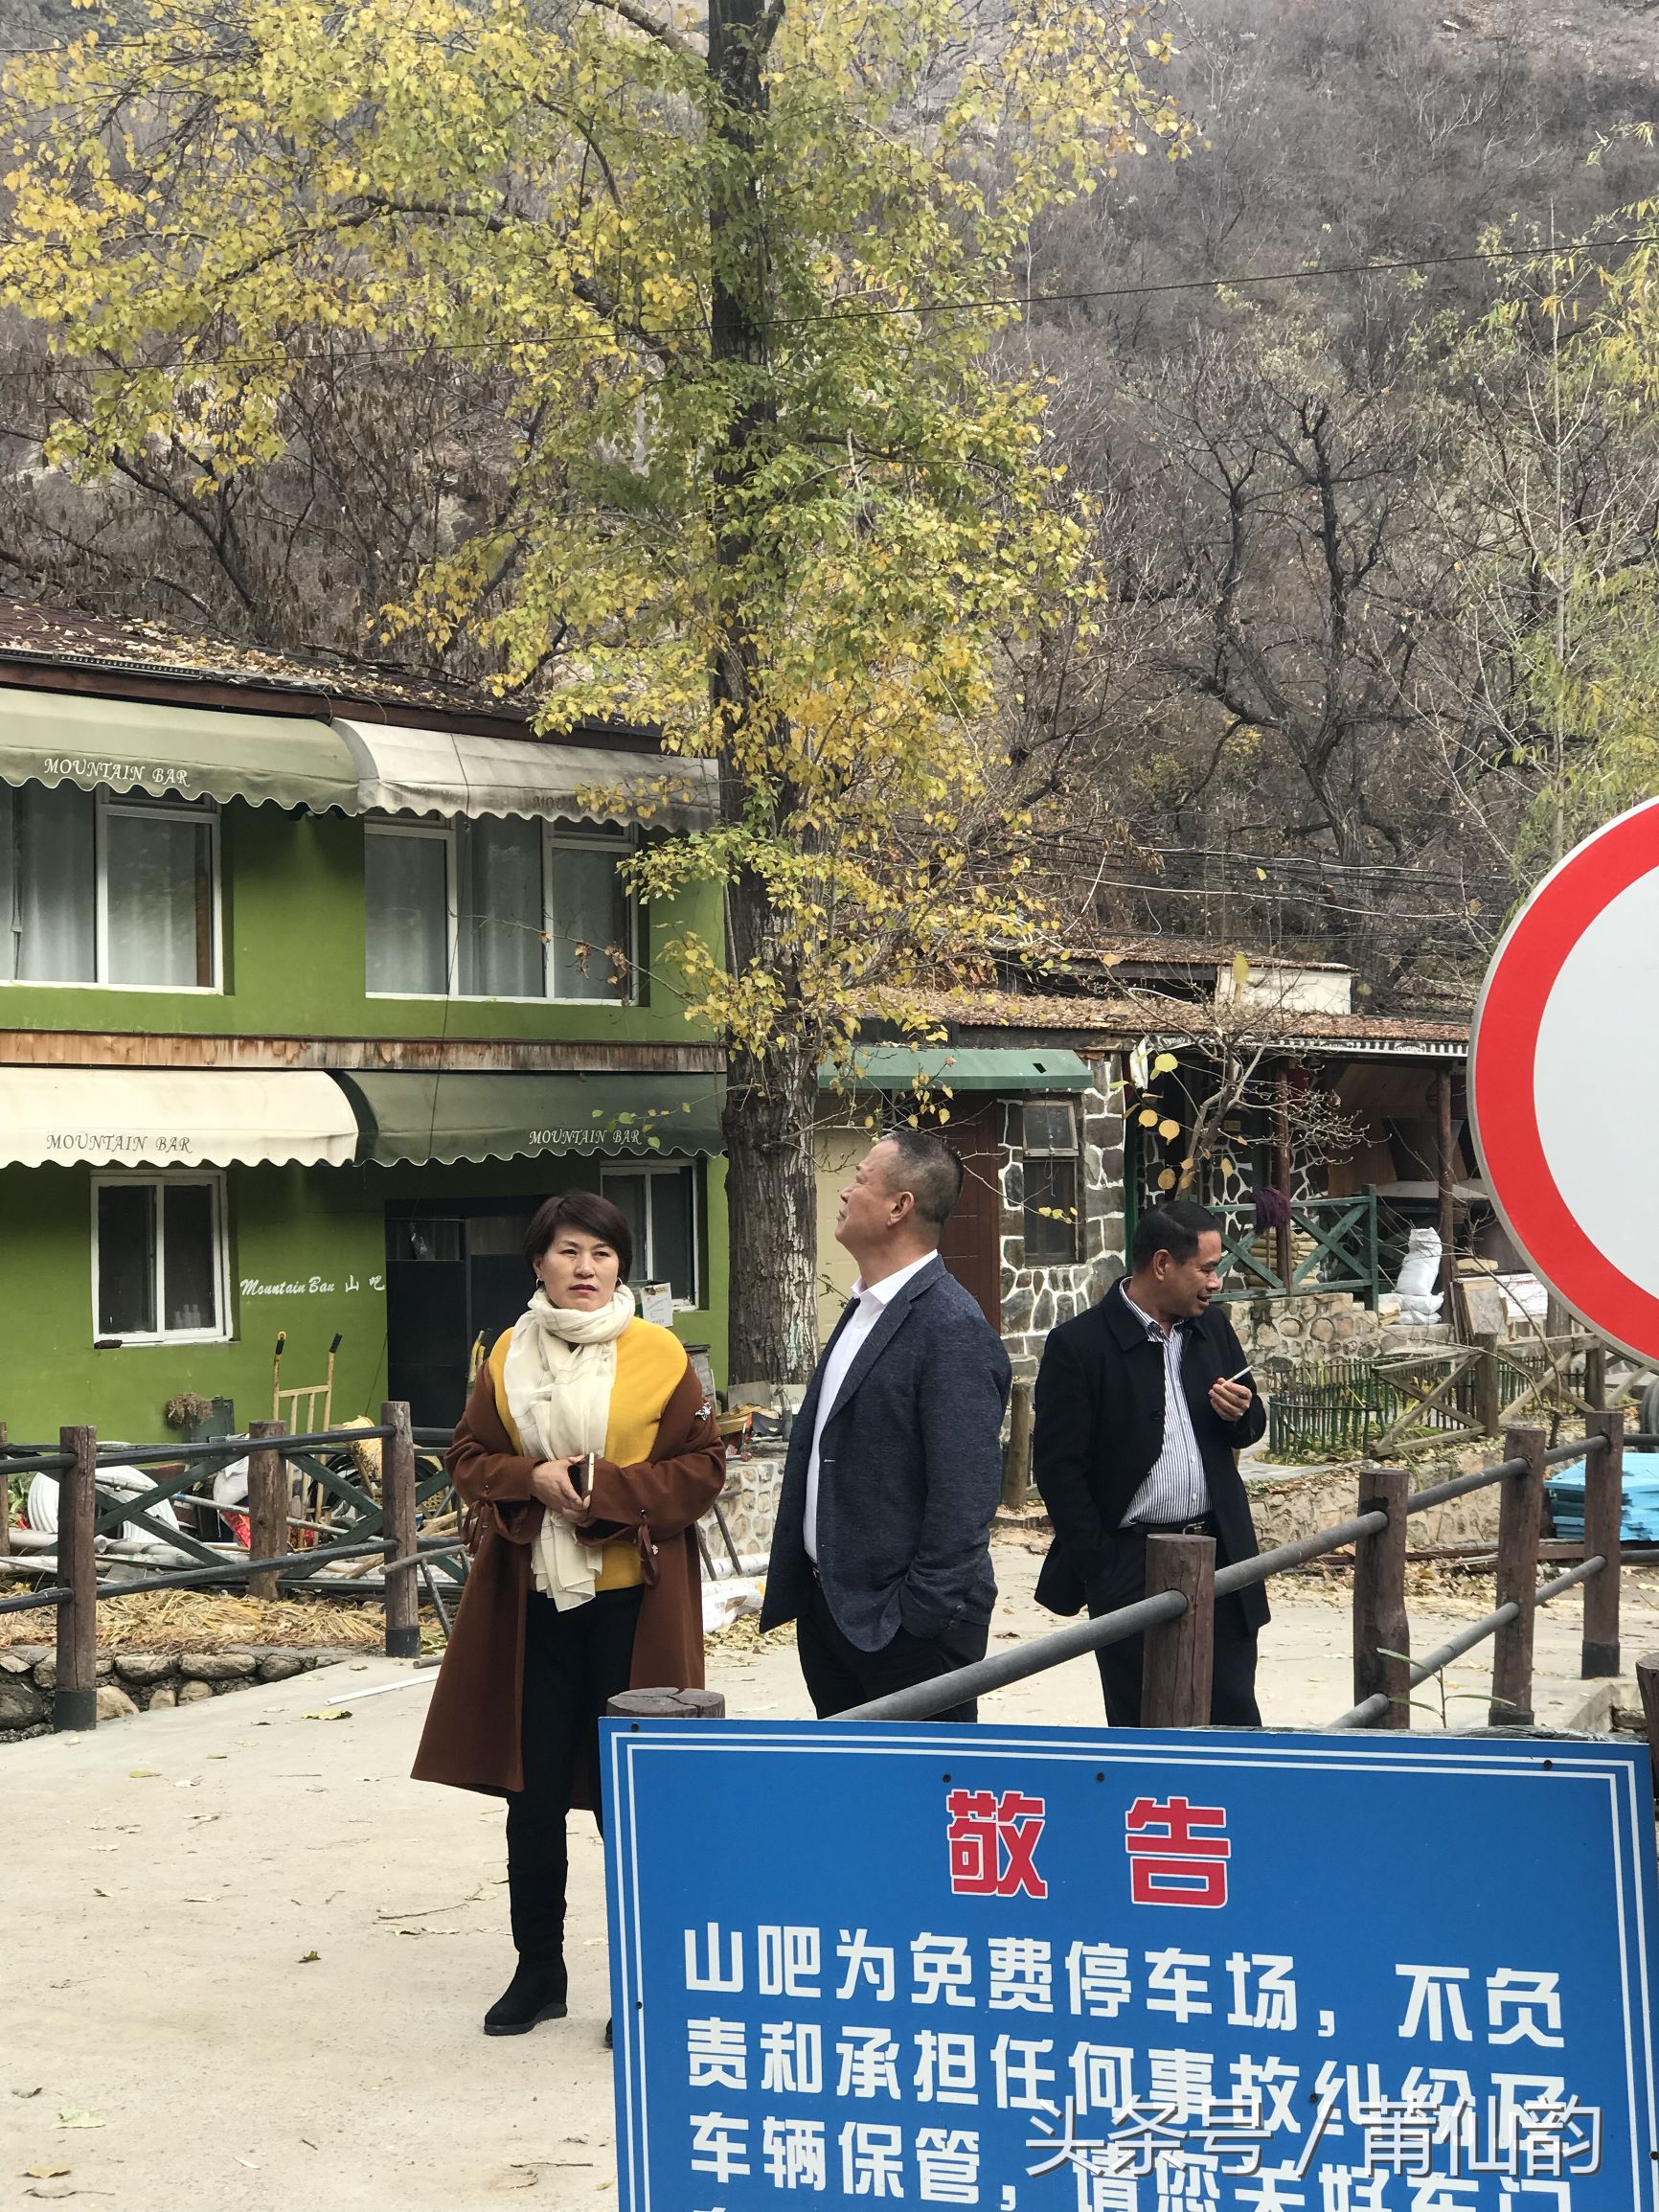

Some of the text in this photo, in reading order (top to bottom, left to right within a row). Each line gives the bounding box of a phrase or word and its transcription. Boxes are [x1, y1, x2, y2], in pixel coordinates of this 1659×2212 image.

[43, 757, 191, 788] MOUNTAIN BAR
[46, 1133, 193, 1153] MOUNTAIN BAR
[529, 1129, 642, 1146] MOUNTAIN BAR
[239, 1278, 307, 1296] Mountain
[946, 1789, 1232, 1908] 敬告
